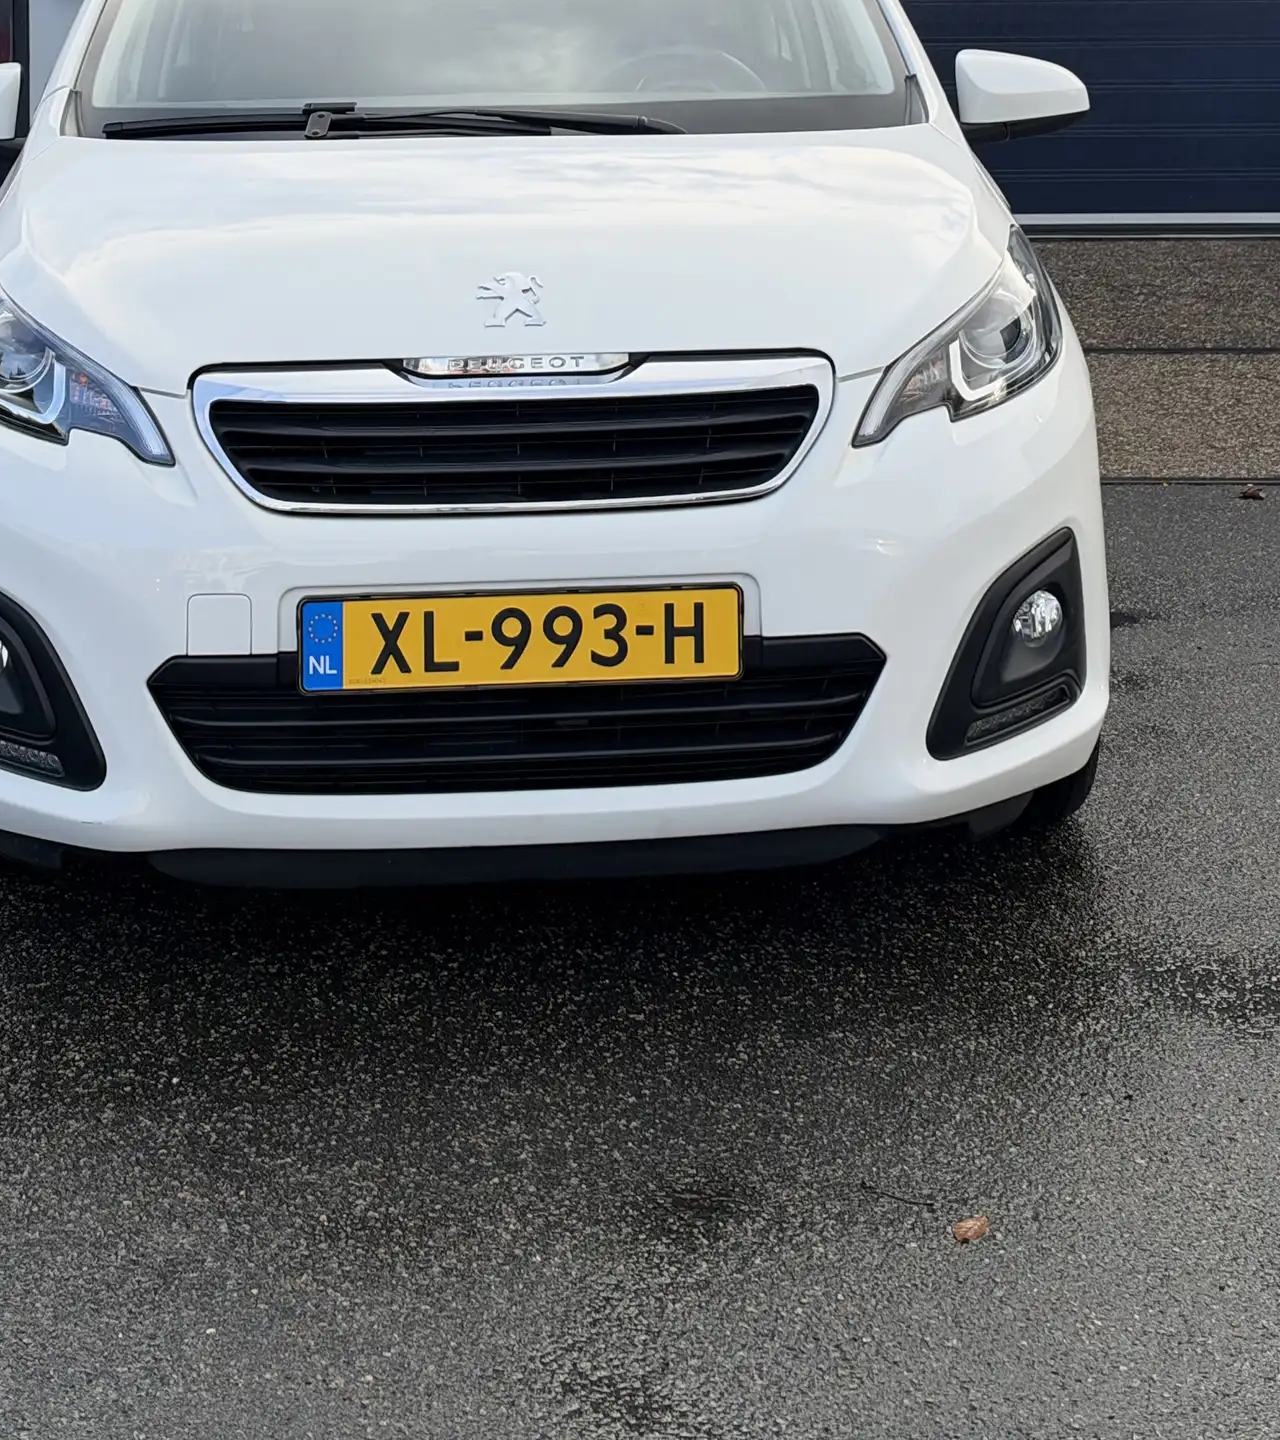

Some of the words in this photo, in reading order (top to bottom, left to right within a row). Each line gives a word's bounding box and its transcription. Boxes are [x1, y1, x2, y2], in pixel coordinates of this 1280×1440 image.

[448, 356, 585, 373] PEUGEOT
[370, 601, 705, 676] XL-993-H
[308, 655, 338, 676] NL
